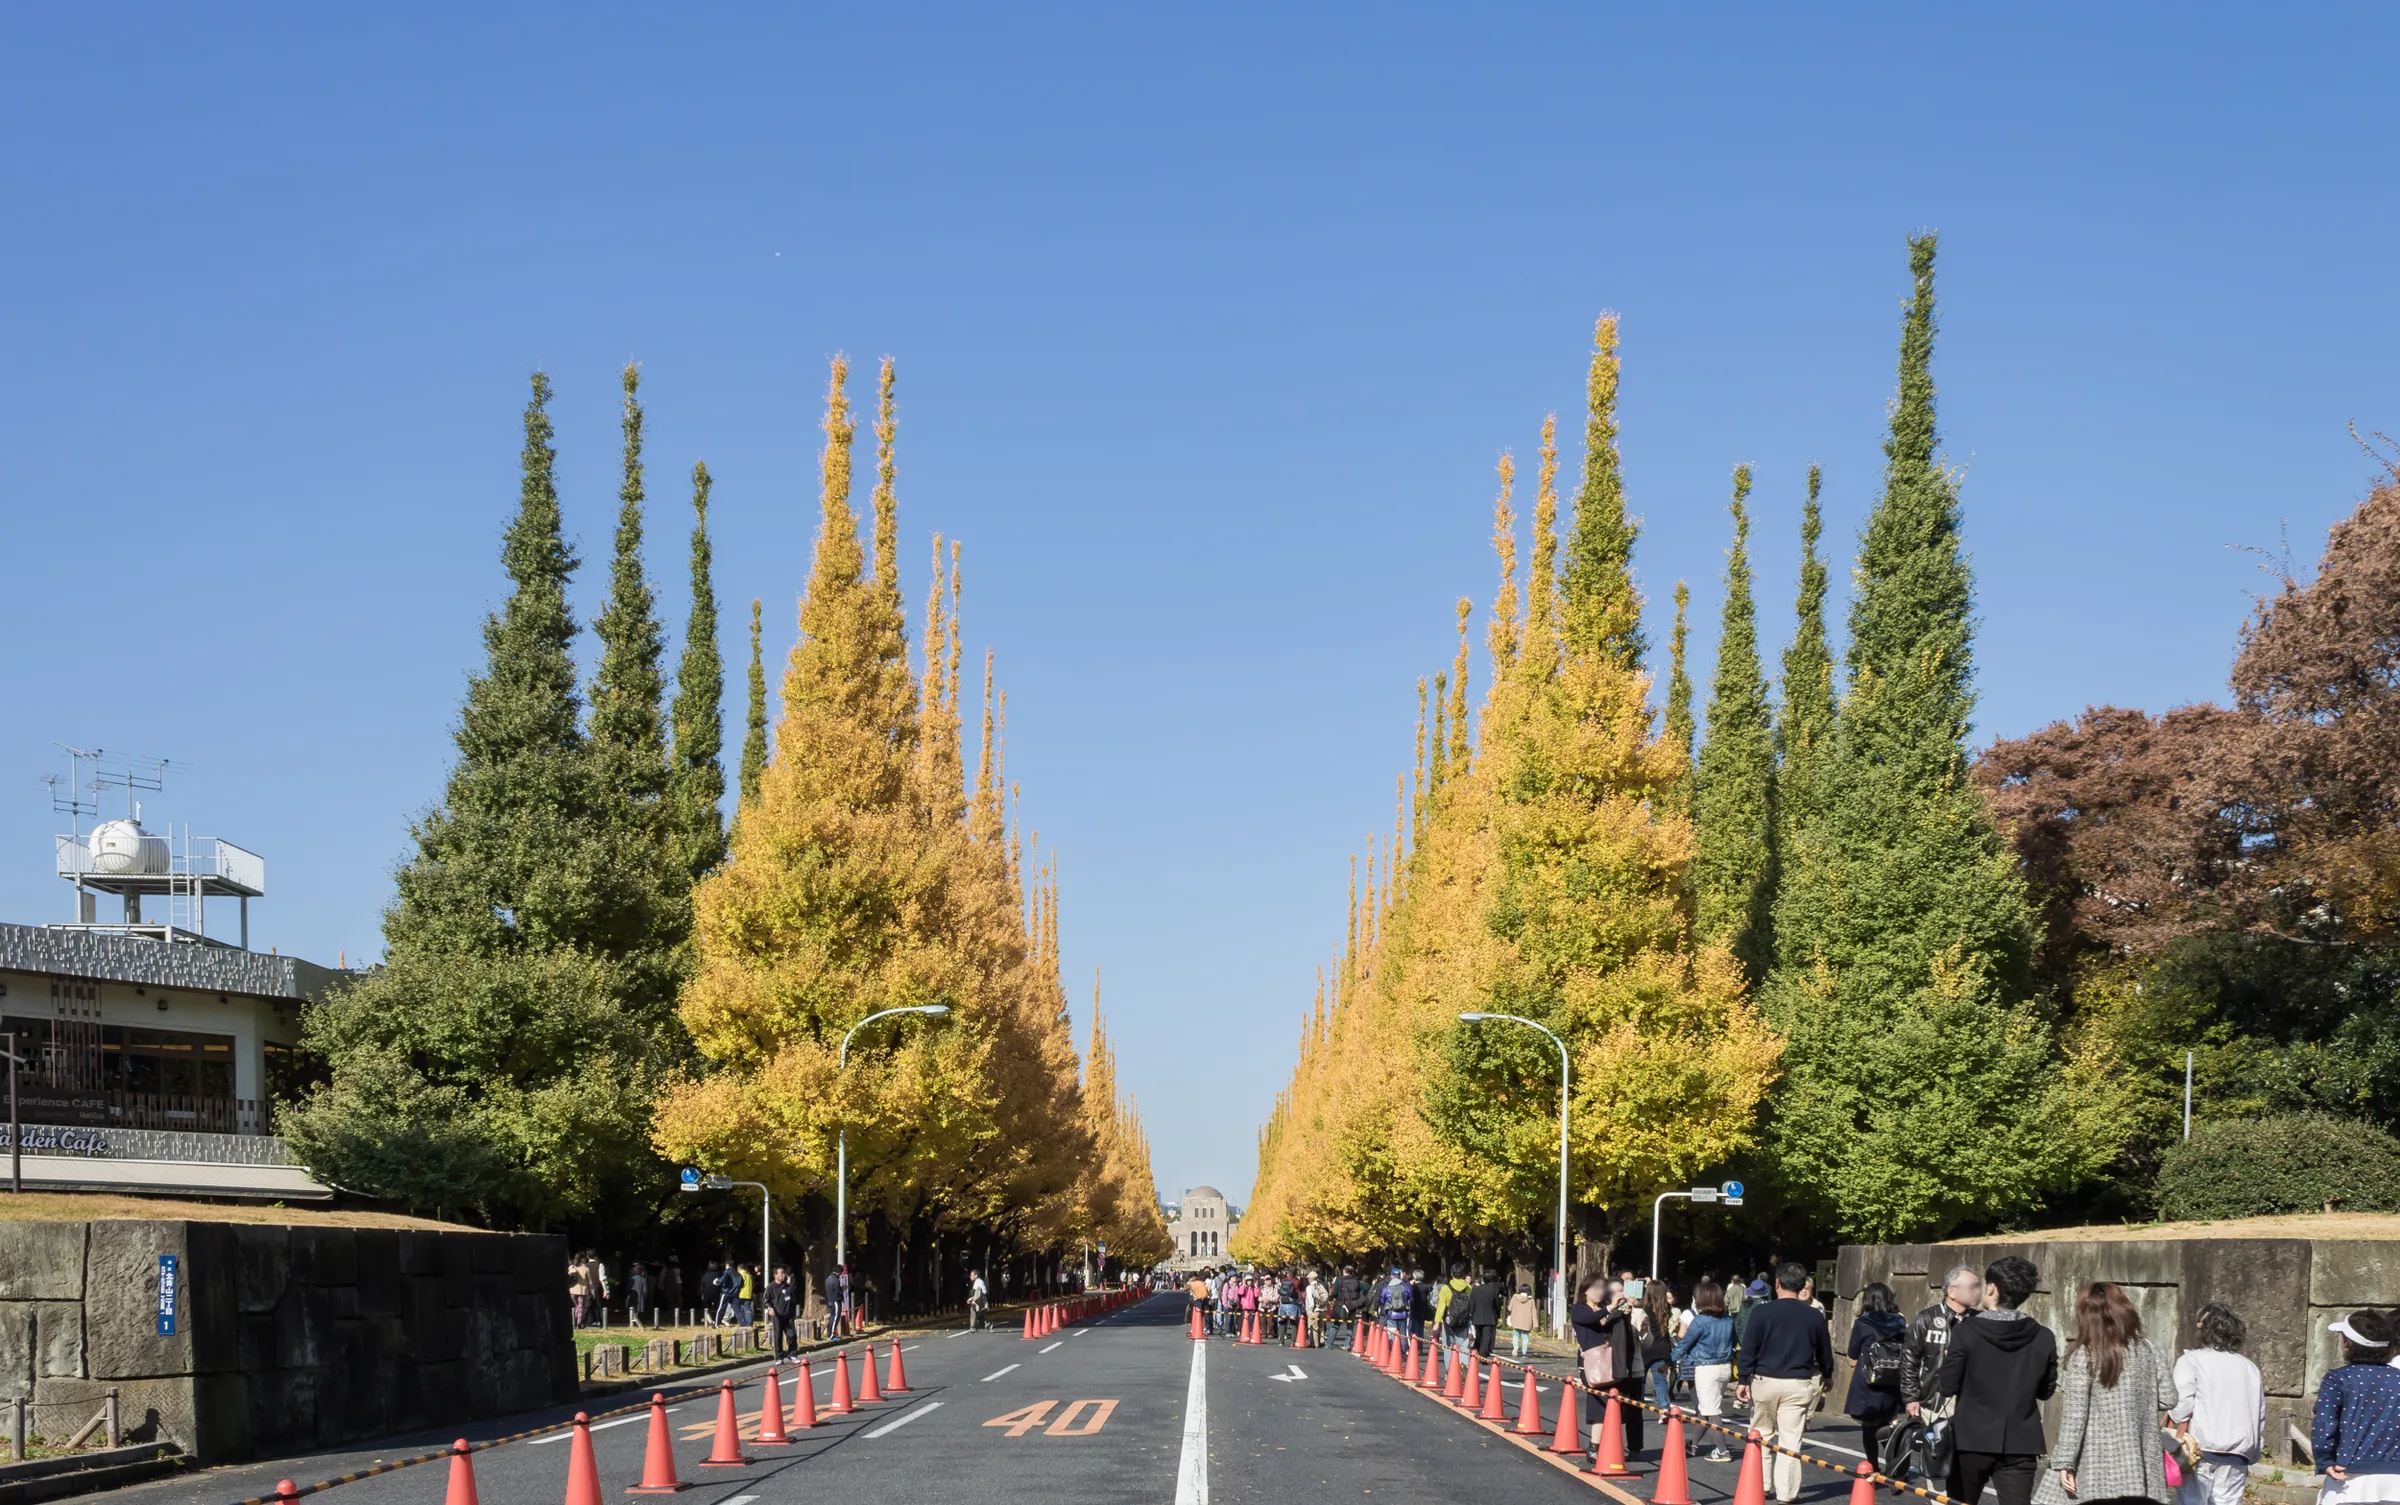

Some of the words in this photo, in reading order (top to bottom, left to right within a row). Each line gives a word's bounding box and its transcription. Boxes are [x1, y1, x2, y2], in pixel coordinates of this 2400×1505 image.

[3, 1094, 69, 1108] Eperience
[72, 1098, 105, 1109] CAFE
[0, 1129, 58, 1148] aden
[60, 1130, 107, 1156] Cafe
[163, 1320, 169, 1330] 1
[981, 1399, 1120, 1437] 40
